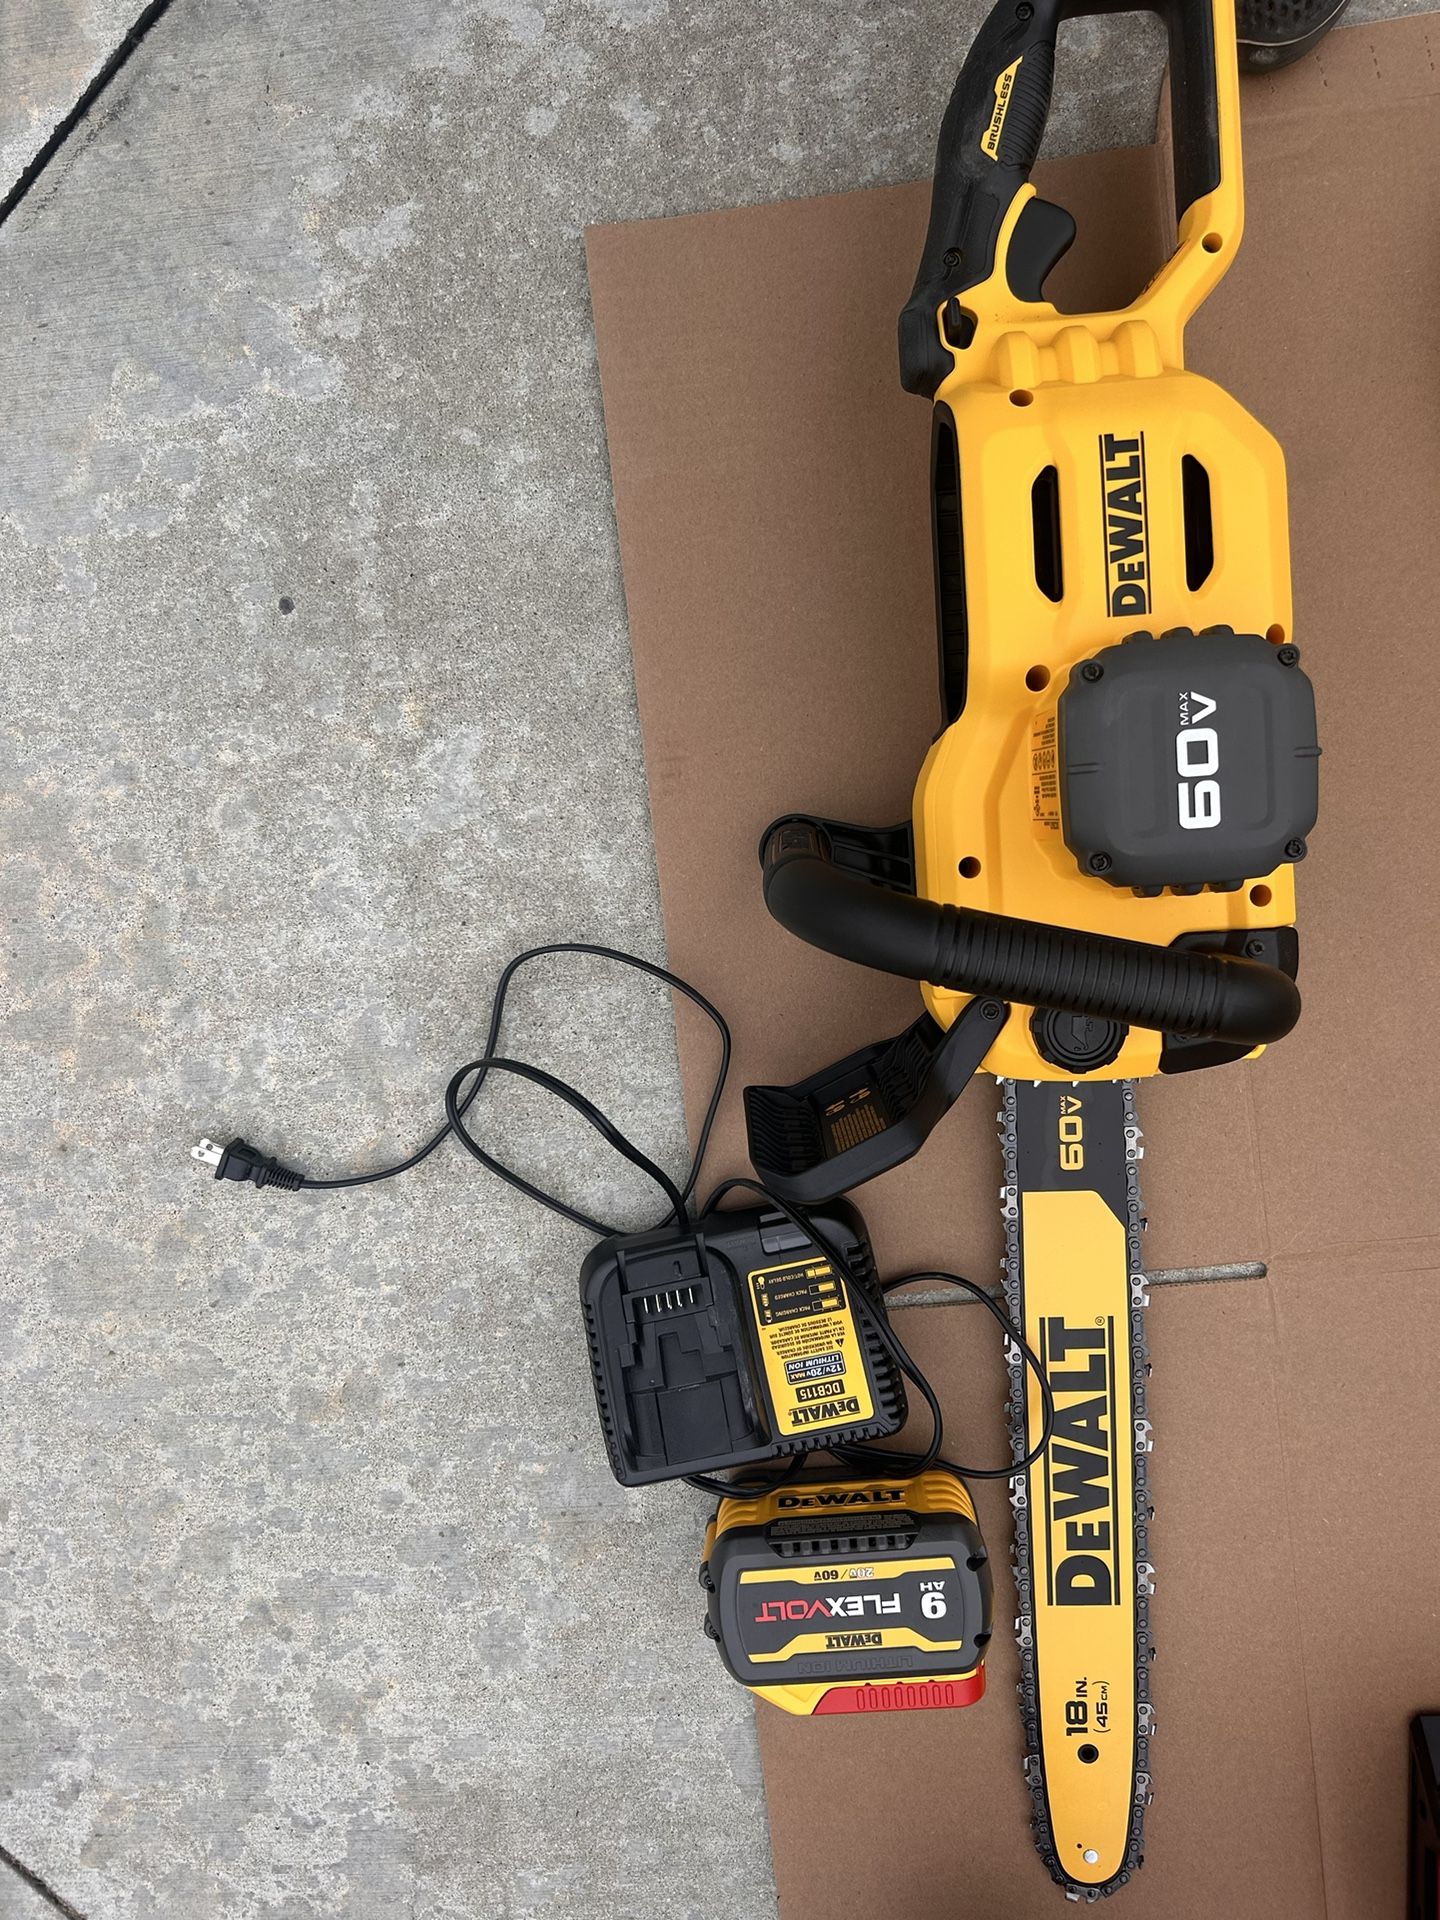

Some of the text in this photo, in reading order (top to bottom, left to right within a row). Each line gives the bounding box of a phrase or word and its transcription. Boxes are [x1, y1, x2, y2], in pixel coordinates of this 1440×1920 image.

[987, 74, 1012, 150] BRUSHLESS
[1104, 433, 1146, 617] DEWALT
[1179, 692, 1189, 725] MAX
[773, 1291, 795, 1300] CHARGED
[775, 1307, 798, 1316] CHARGING
[787, 1354, 839, 1370] LITHIUM ION
[789, 1370, 805, 1380] MAX
[799, 1381, 840, 1400] DCB115
[789, 1398, 859, 1424] DEWALT
[1047, 1316, 1112, 1605] DEWALT
[778, 1489, 905, 1510] DEWALT
[920, 1581, 945, 1591] AH
[755, 1593, 901, 1623] FLEXVOLT
[921, 1592, 947, 1619] 9
[825, 1632, 883, 1649] DEWALT
[836, 1656, 913, 1673] LITHIUM
